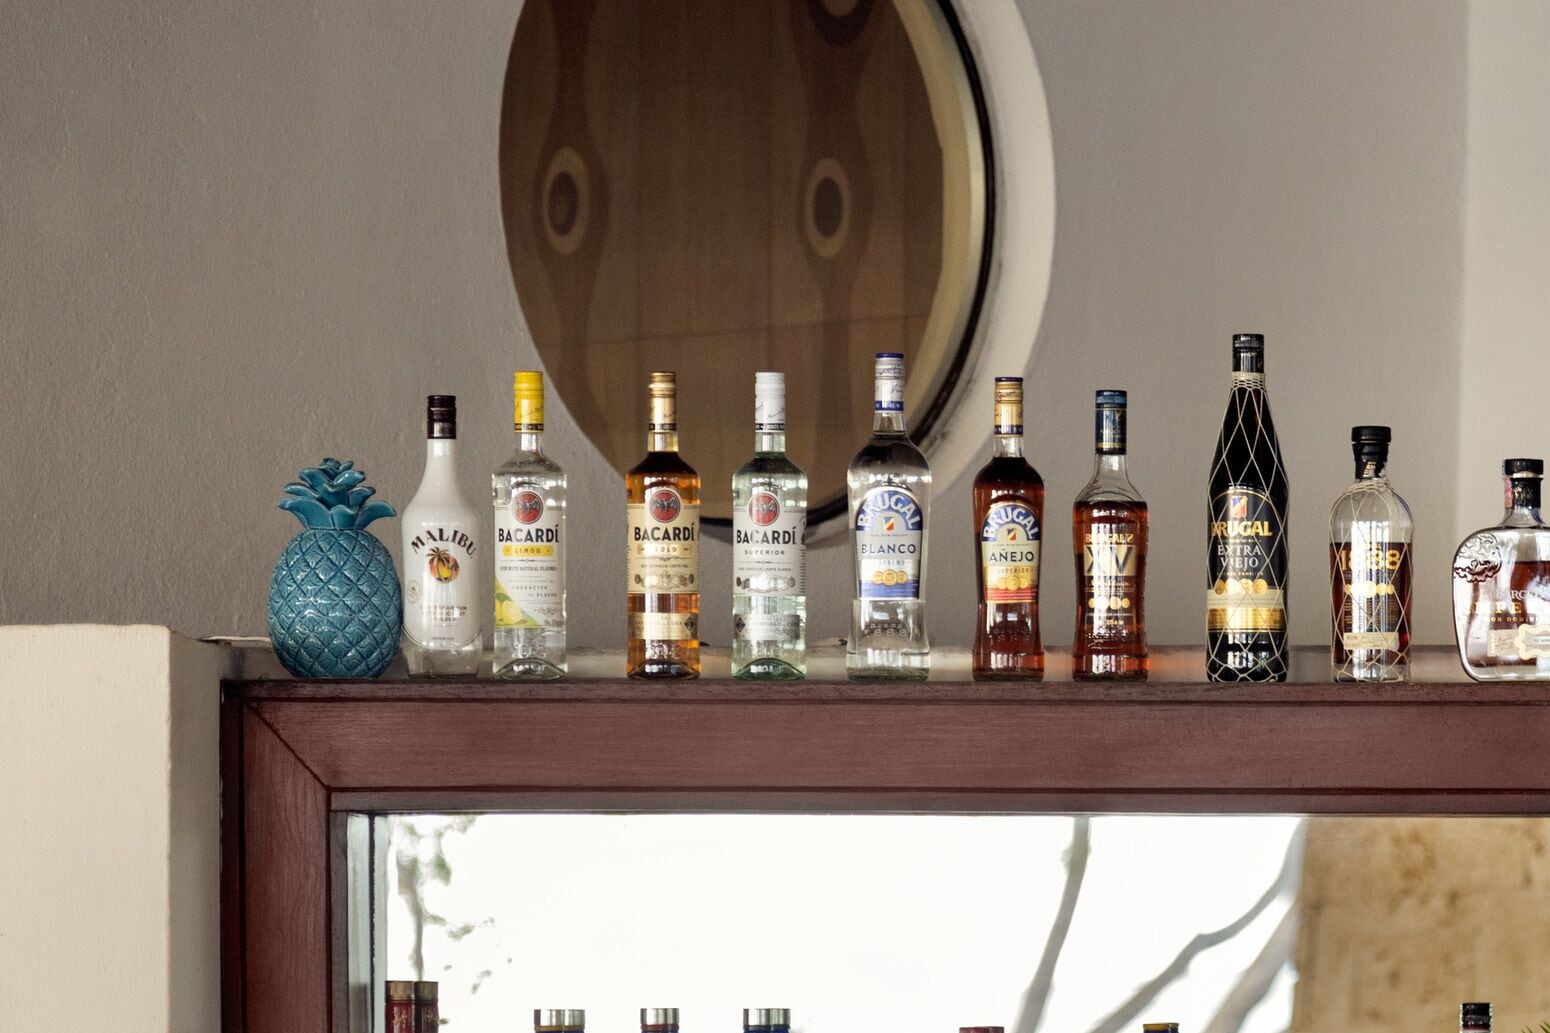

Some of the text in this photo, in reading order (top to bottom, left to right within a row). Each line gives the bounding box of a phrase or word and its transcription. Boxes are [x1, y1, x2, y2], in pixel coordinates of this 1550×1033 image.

[857, 493, 921, 528] BRUGAL
[634, 522, 695, 542] BACARDÍ
[983, 507, 1039, 539] BRUGAL
[1211, 520, 1273, 537] BRUGAL
[410, 527, 477, 556] MALIBU
[498, 524, 560, 543] BACARDÍ
[736, 526, 797, 545] BACARDÍ
[1085, 533, 1124, 543] BGAL
[861, 543, 916, 554] BLANCO
[990, 548, 1035, 562] AÑEJO
[1217, 544, 1261, 556] EXTRA
[1220, 556, 1259, 572] VIEJO
[1341, 549, 1400, 570] 188
